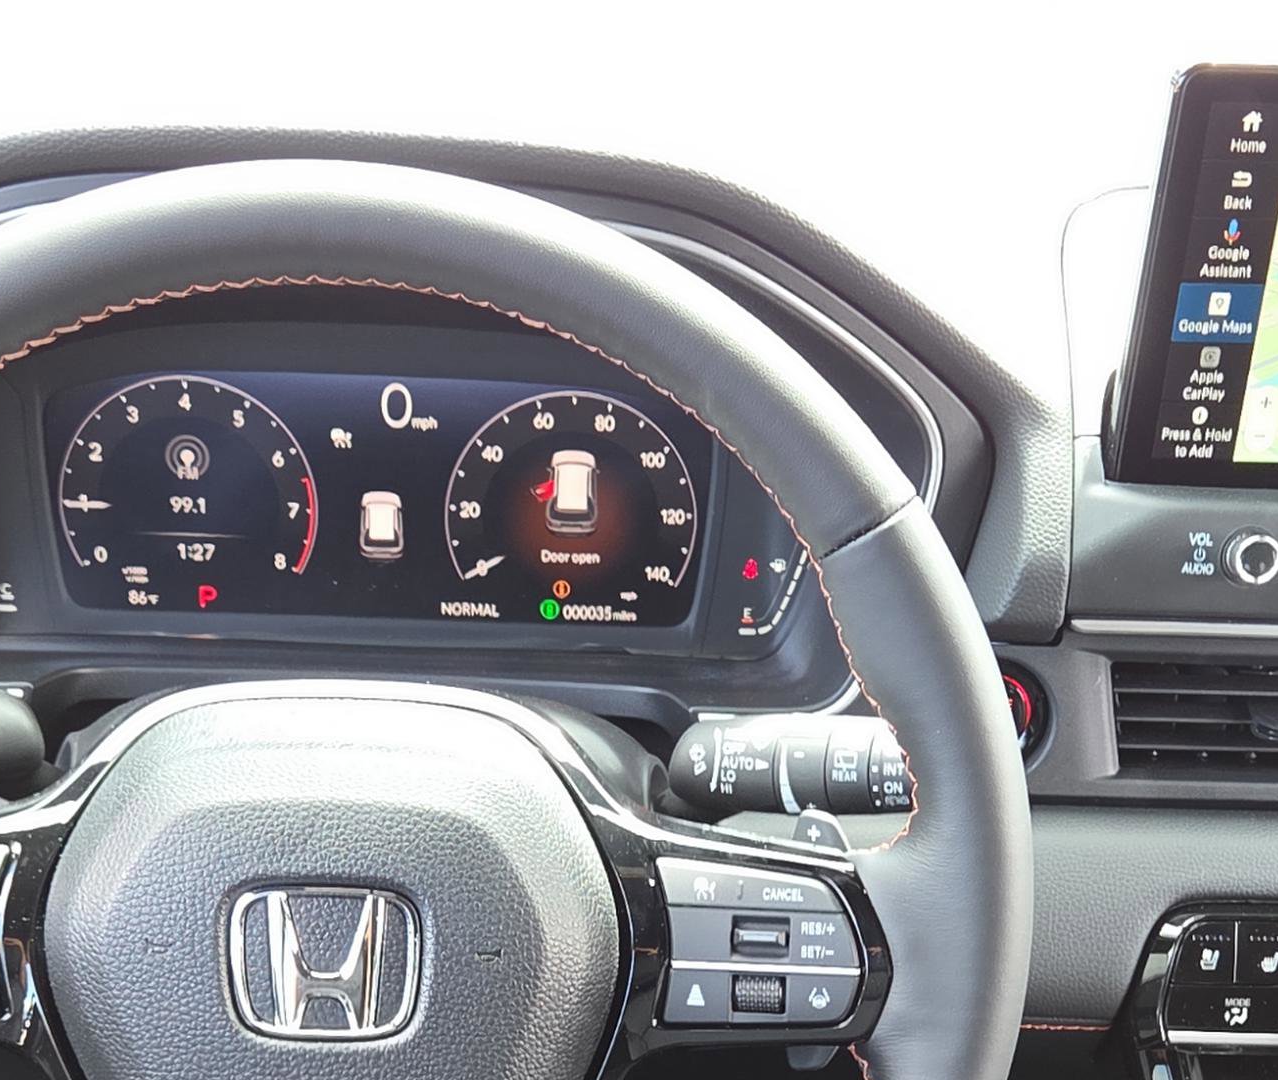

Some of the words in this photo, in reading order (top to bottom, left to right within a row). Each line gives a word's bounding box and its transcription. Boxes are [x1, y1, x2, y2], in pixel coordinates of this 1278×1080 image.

[1230, 138, 1267, 153] Home
[1224, 195, 1252, 210] Back
[1208, 245, 1250, 262] Google
[1200, 263, 1252, 278] Assistant
[1179, 319, 1219, 335] Google
[1222, 320, 1252, 335] Maps
[1190, 369, 1224, 384] Apple
[178, 393, 192, 411] 4
[1182, 386, 1225, 402] CarPlay
[126, 405, 139, 424] 3
[381, 383, 413, 429] 0
[412, 416, 438, 432] mph
[232, 409, 245, 427] 5
[533, 413, 555, 430] 60
[594, 414, 615, 432] 80
[1161, 427, 1190, 441] Press
[1193, 428, 1202, 442] &
[1205, 428, 1233, 442] Hold
[88, 442, 103, 462] 2
[481, 445, 503, 463] 40
[1175, 445, 1187, 458] to
[1188, 444, 1213, 458] Add
[272, 451, 285, 468] 6
[640, 451, 666, 469] 100
[169, 496, 206, 515] 99.1
[287, 502, 299, 519] 7
[459, 501, 481, 519] 20
[660, 508, 686, 525] 120
[1189, 532, 1213, 547] VOL
[94, 546, 108, 562] 0
[177, 543, 215, 561] 1:27
[541, 549, 570, 563] Door
[571, 552, 601, 565] open
[274, 553, 286, 570] 8
[1181, 562, 1215, 576] AUDIO
[645, 566, 670, 582] 140
[0, 582, 12, 595] C
[198, 585, 218, 608] P
[440, 602, 500, 618] NORMAL
[562, 604, 612, 621] 000035
[612, 610, 637, 621] miles
[743, 607, 753, 618] E
[722, 757, 753, 770] AUTO
[883, 763, 905, 776] INT
[721, 770, 736, 782] LO
[832, 770, 857, 782] REAR
[883, 782, 903, 794] ON
[762, 887, 804, 902] CANCEL
[1224, 998, 1251, 1007] MODE
